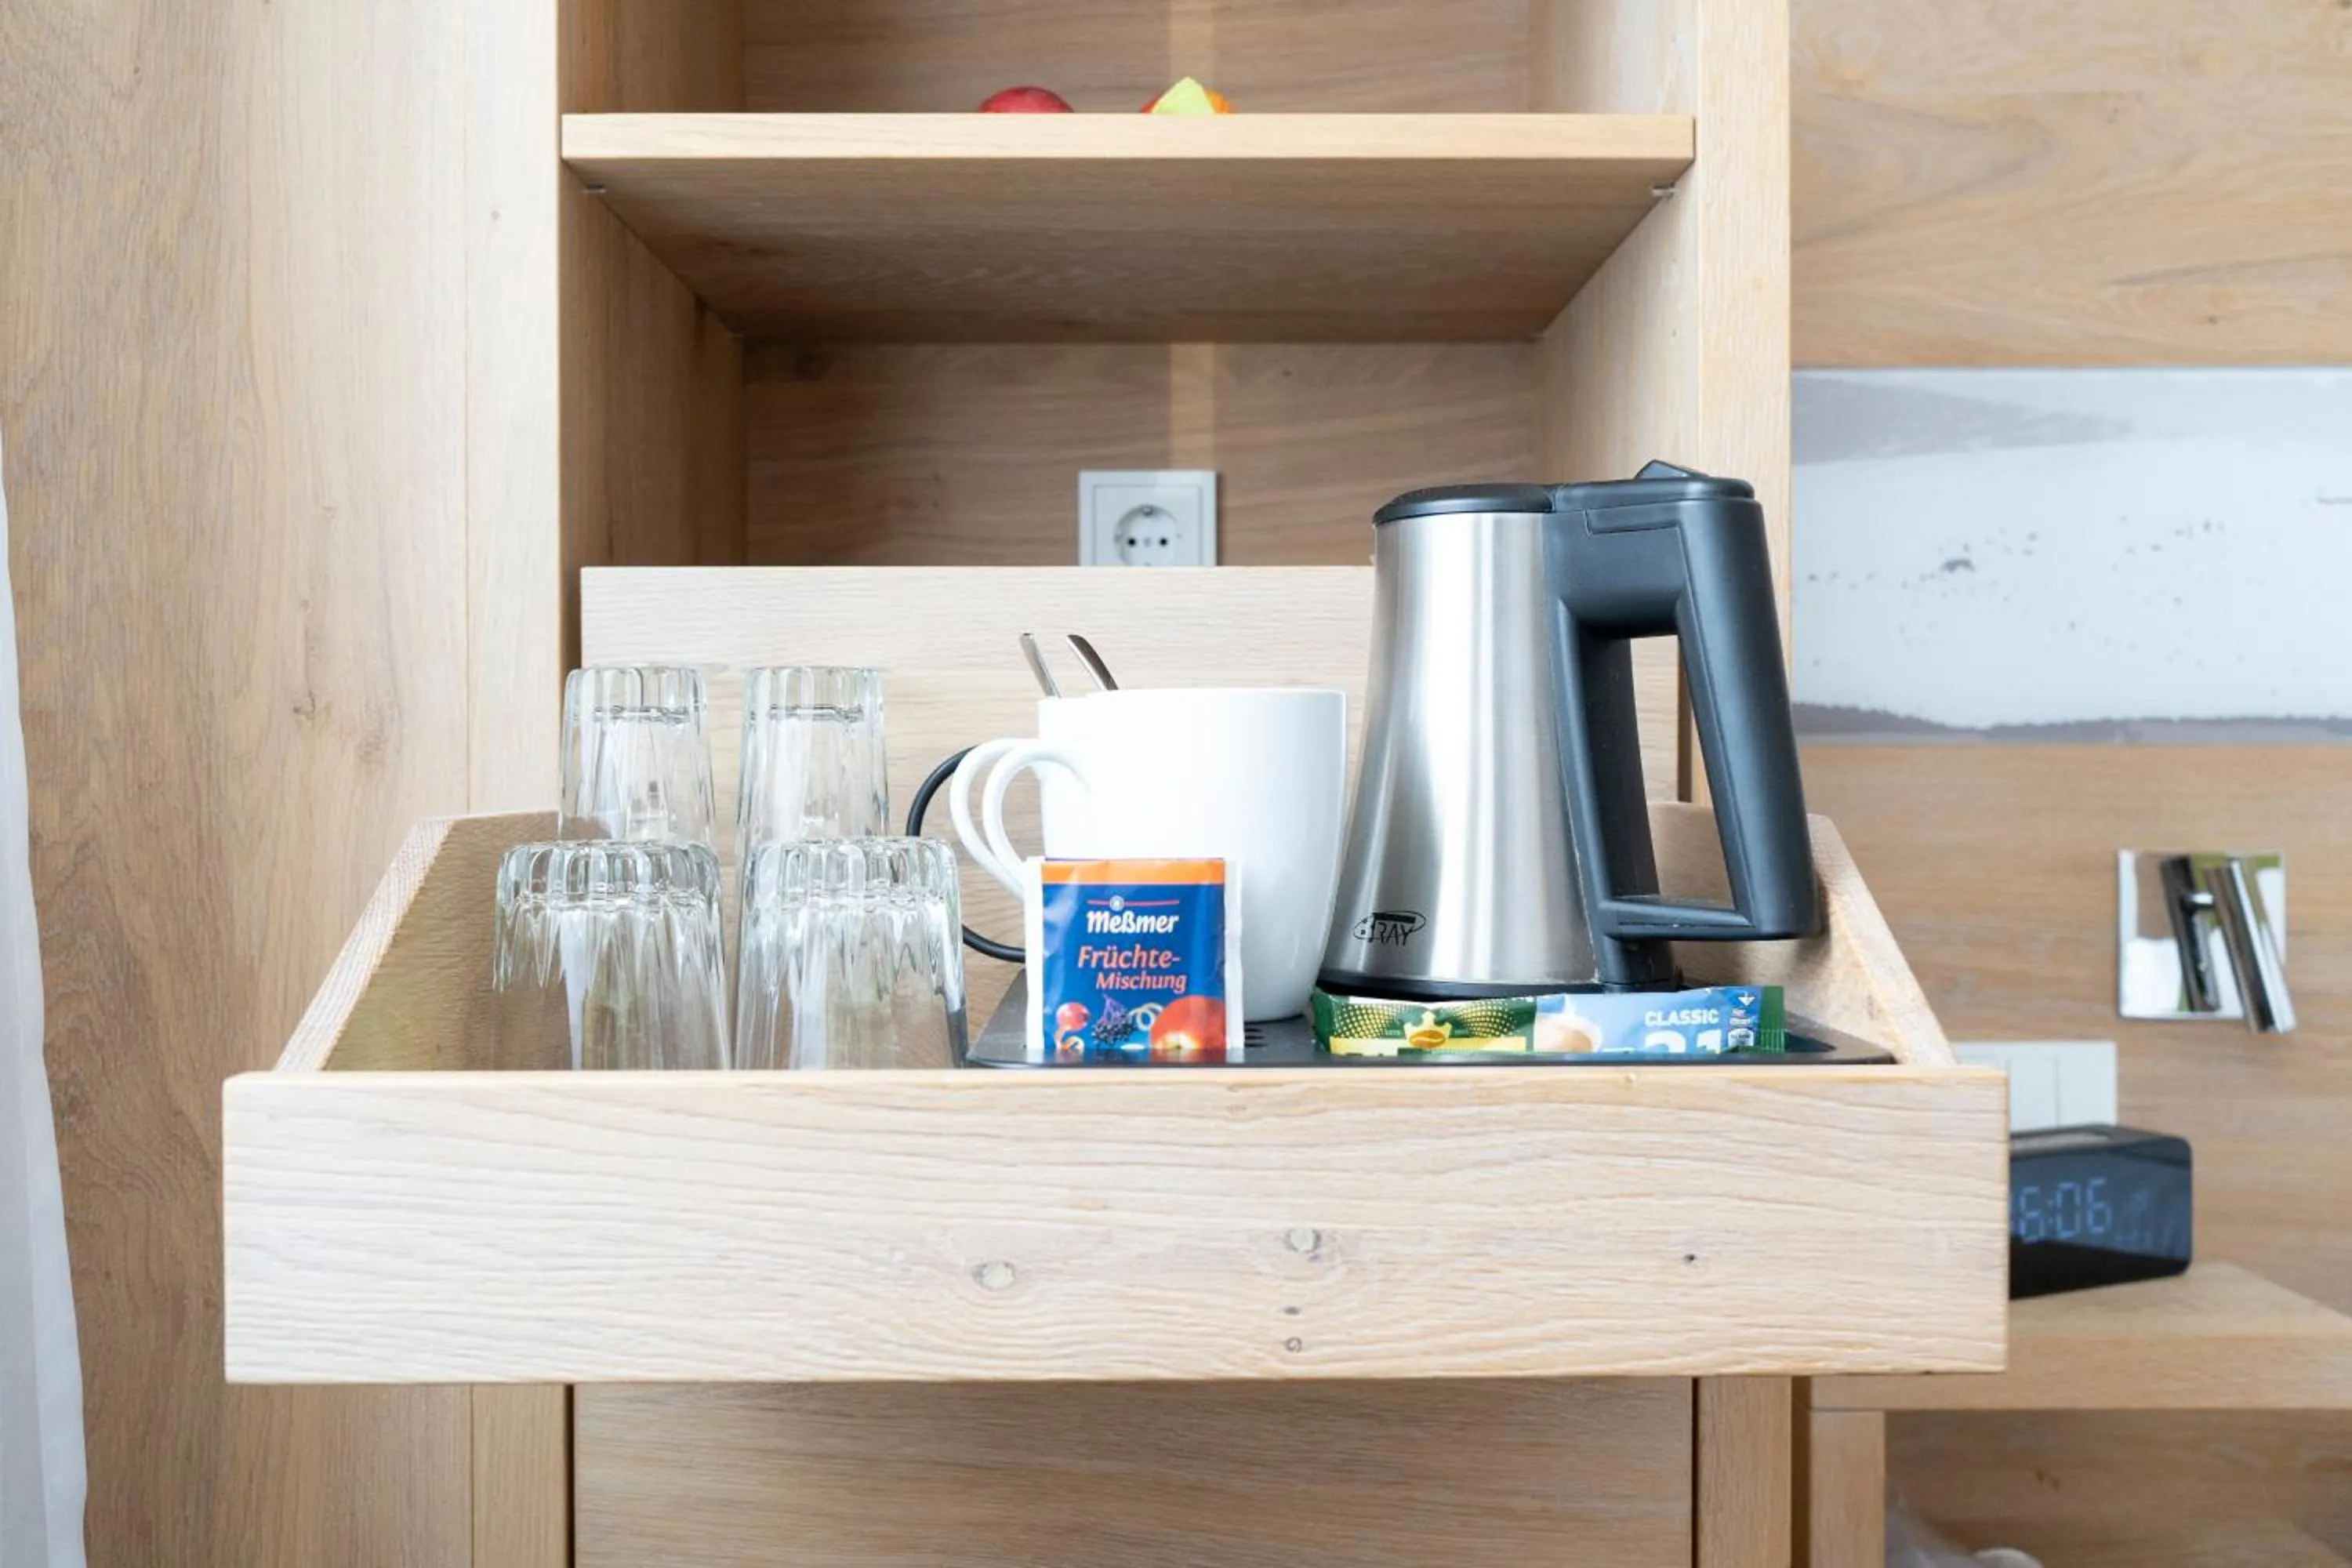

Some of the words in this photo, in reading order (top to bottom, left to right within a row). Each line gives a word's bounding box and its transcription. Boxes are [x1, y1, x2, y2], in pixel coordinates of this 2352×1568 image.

[1087, 909, 1179, 934] Meßmer
[1077, 944, 1181, 969] Früchte-
[1095, 971, 1188, 994] Mischung
[1645, 1008, 1719, 1026] CLASSIC
[2009, 1177, 2113, 1245] 6:06
